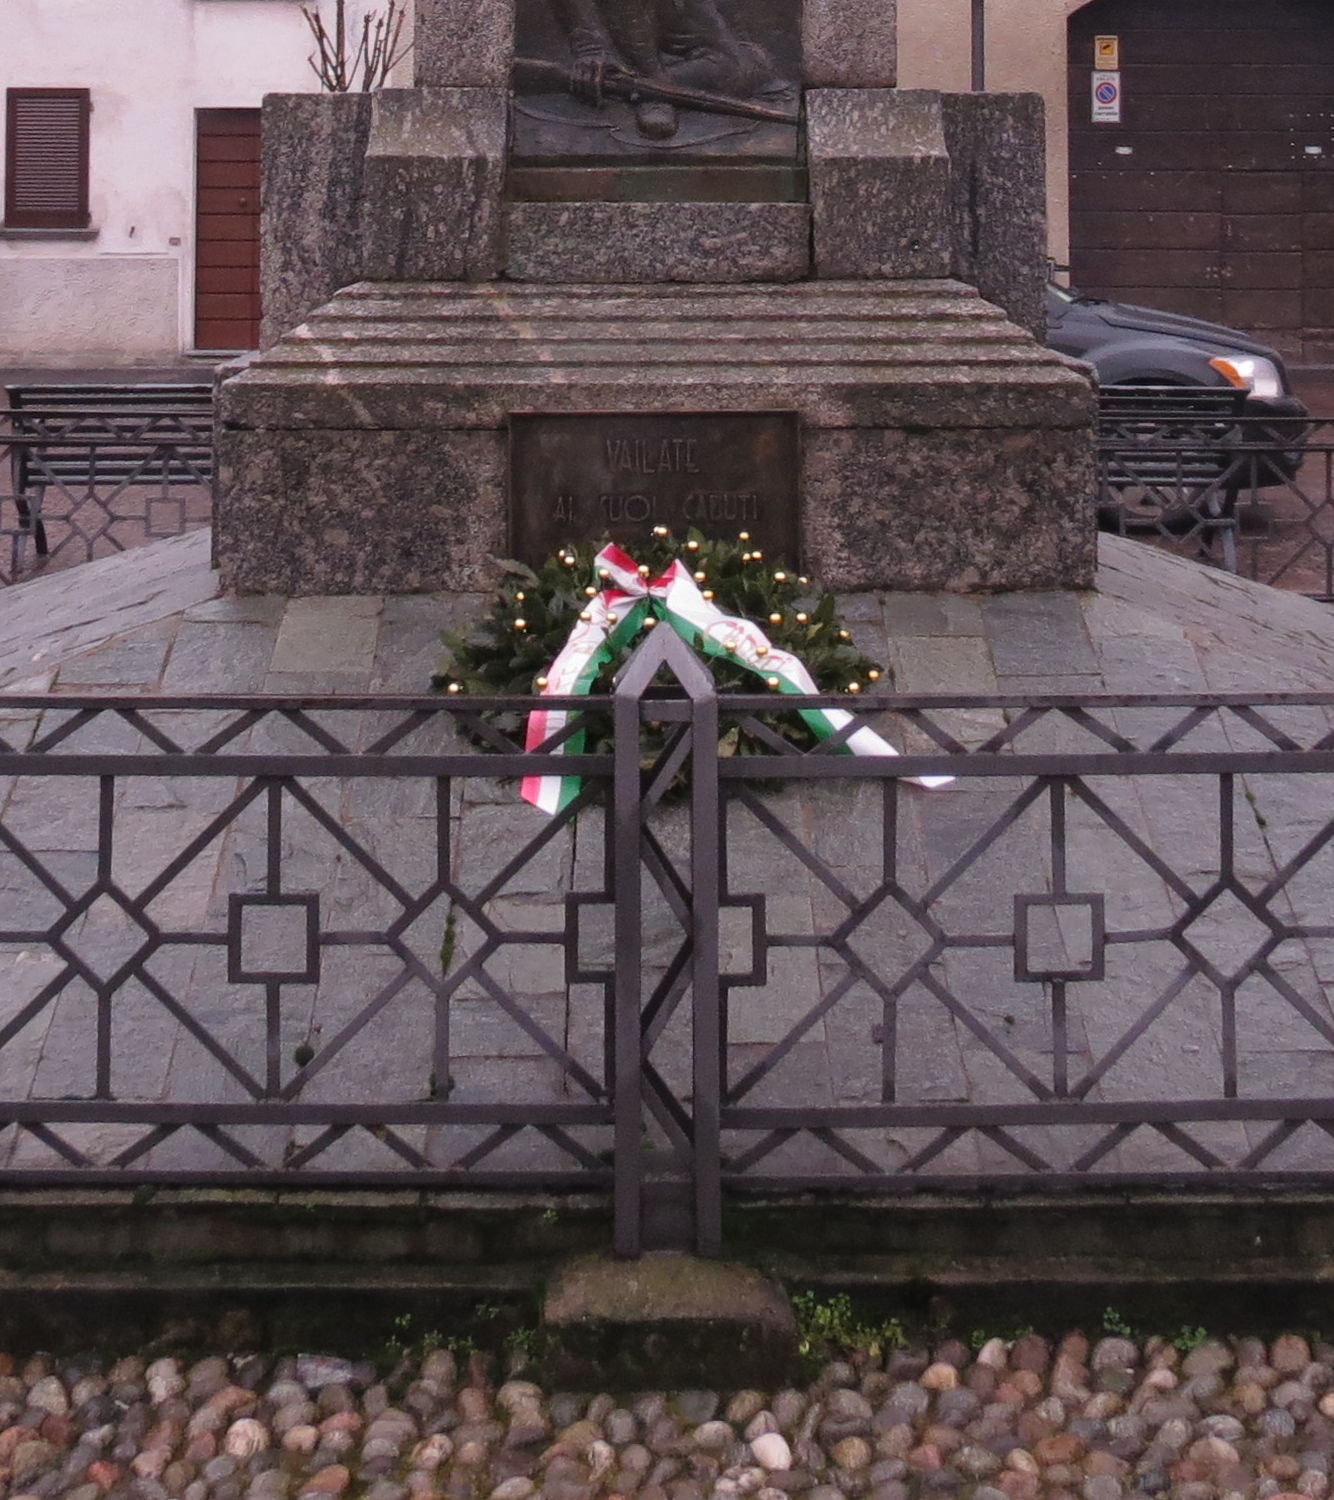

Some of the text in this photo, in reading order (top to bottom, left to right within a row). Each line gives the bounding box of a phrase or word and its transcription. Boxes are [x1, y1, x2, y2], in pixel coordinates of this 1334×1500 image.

[606, 438, 701, 475] VAILATE
[554, 492, 761, 523] AI SUOI CADUTI
